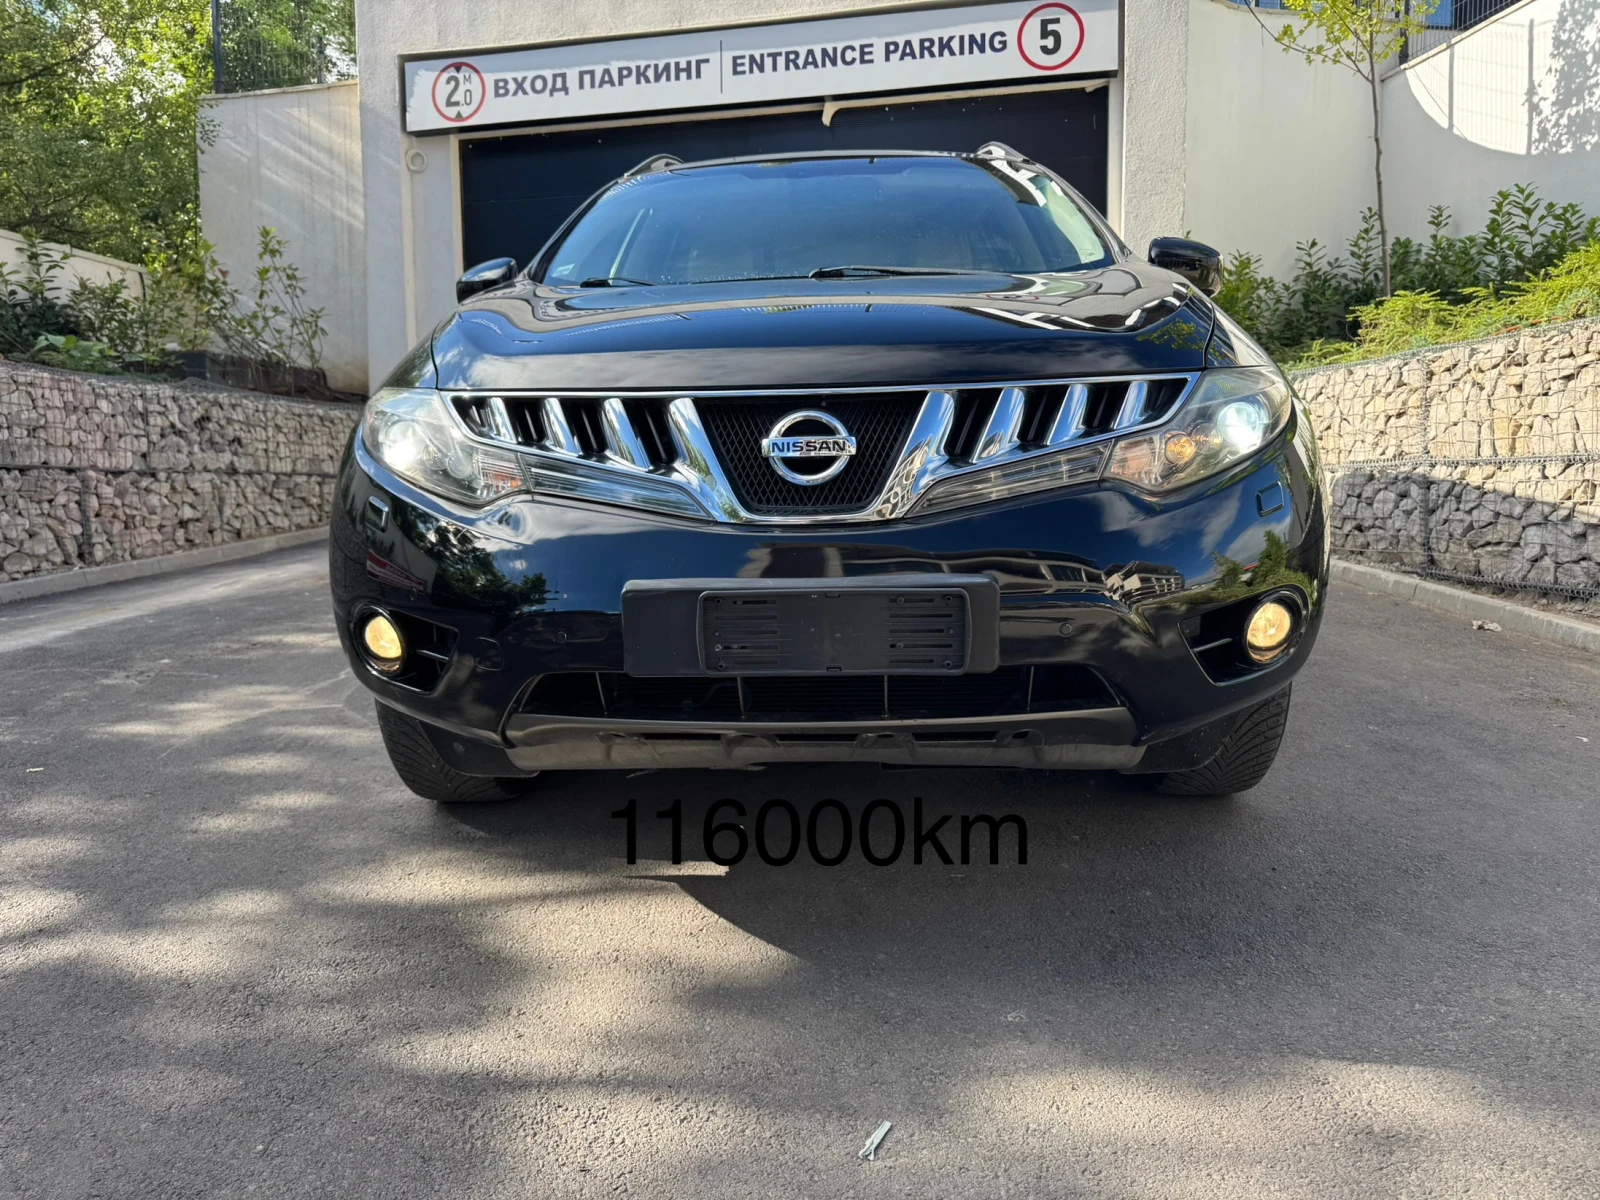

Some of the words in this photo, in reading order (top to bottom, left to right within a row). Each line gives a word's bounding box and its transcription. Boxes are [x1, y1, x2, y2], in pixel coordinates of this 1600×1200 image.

[731, 42, 875, 76] ENTRANCE
[884, 30, 1008, 63] PARKING
[1038, 17, 1063, 56] 5
[493, 73, 570, 99] ВХОД
[577, 57, 711, 92] ПАРКИНГ
[771, 439, 847, 453] NISSAN
